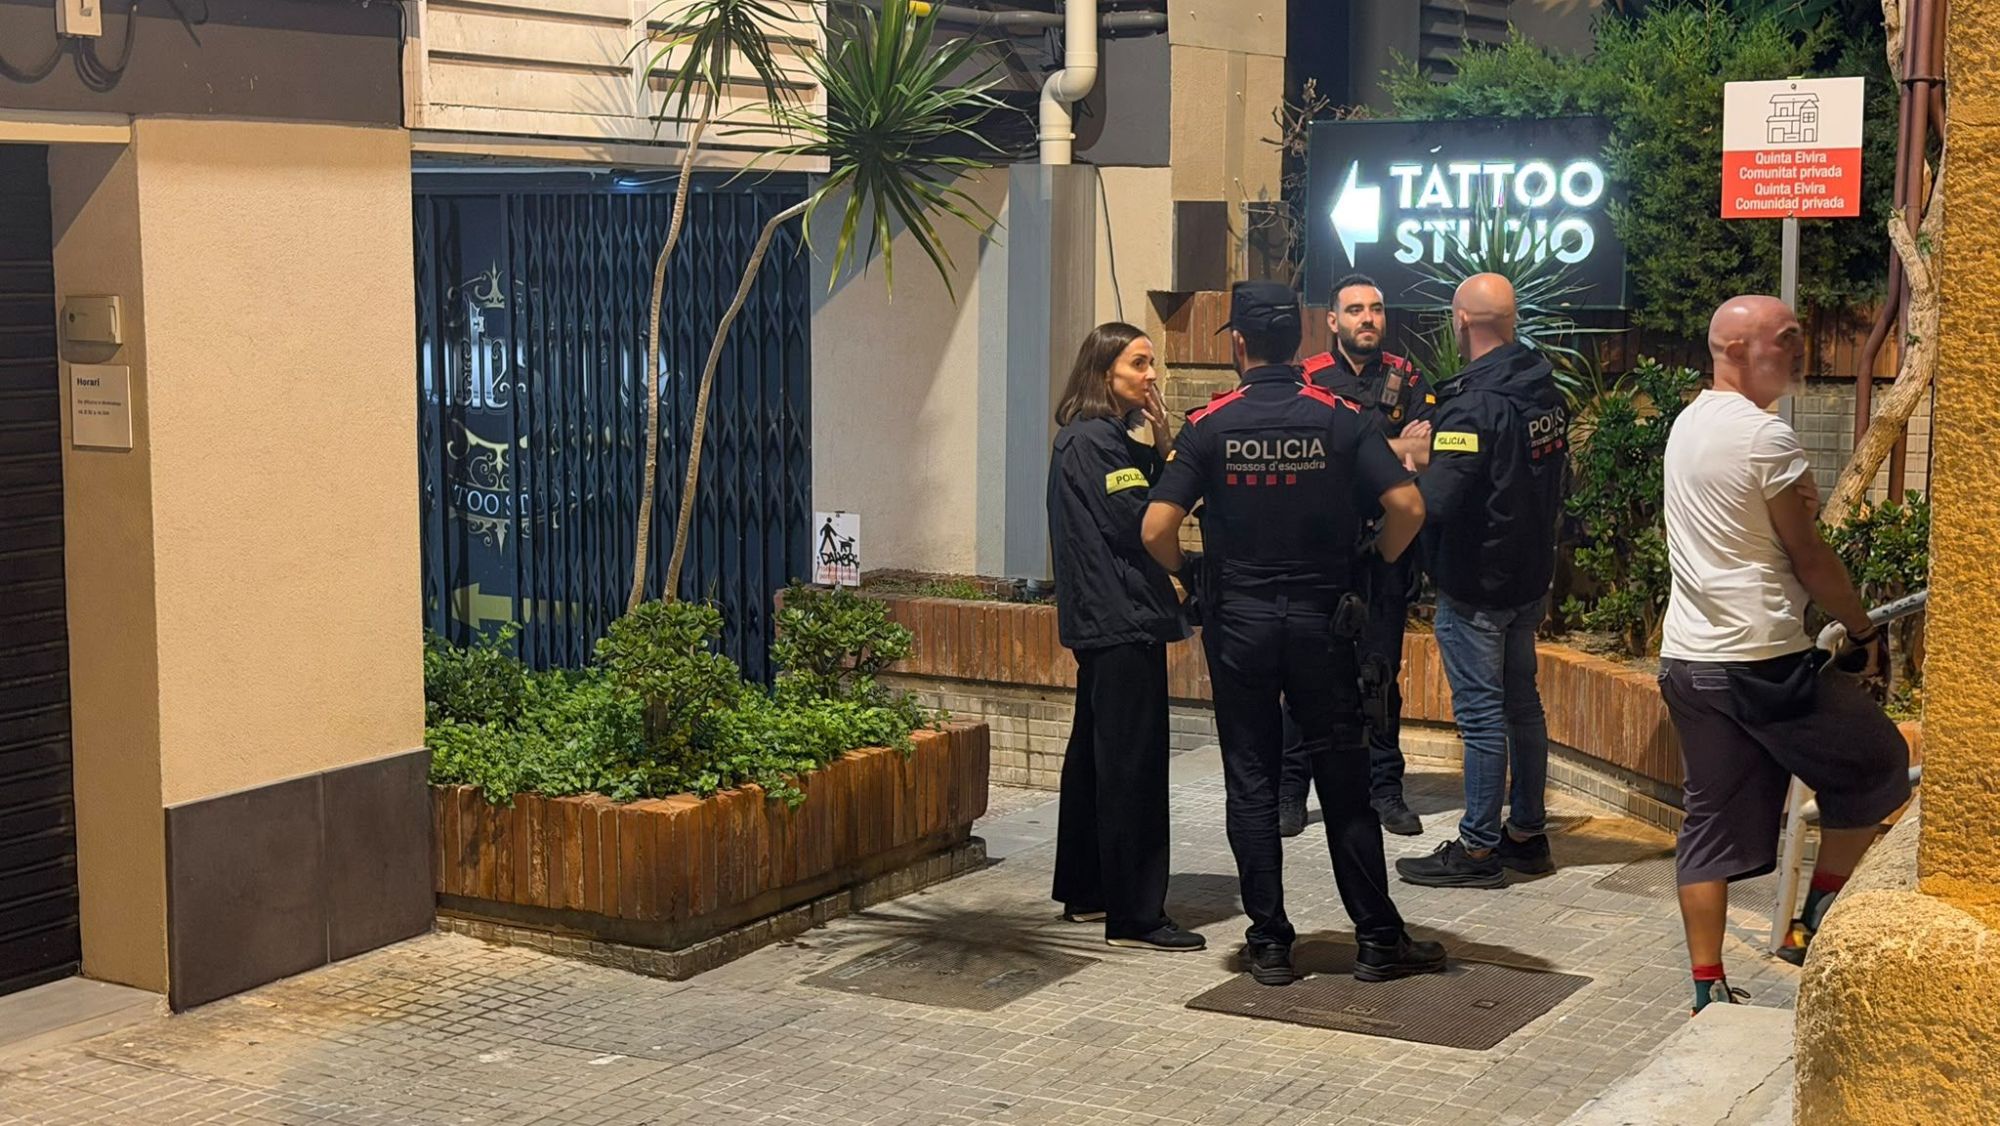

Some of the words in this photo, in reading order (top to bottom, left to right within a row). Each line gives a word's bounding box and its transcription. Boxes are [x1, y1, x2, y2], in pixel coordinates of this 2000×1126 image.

[1755, 151, 1792, 164] Quinta
[1795, 151, 1827, 163] Elvira
[1739, 166, 1797, 180] Comunitat
[1800, 166, 1842, 180] privada
[1390, 161, 1604, 208] TATTOO
[1754, 182, 1791, 196] Quinta
[1794, 182, 1826, 194] Elvira
[1735, 197, 1799, 211] Comunidad
[1802, 197, 1844, 211] privada
[1394, 218, 1595, 265] STUDIO
[77, 377, 100, 386] Horari
[1225, 438, 1326, 459] POLICIA
[1226, 462, 1266, 472] mossos
[1268, 460, 1326, 472] d'esquadra
